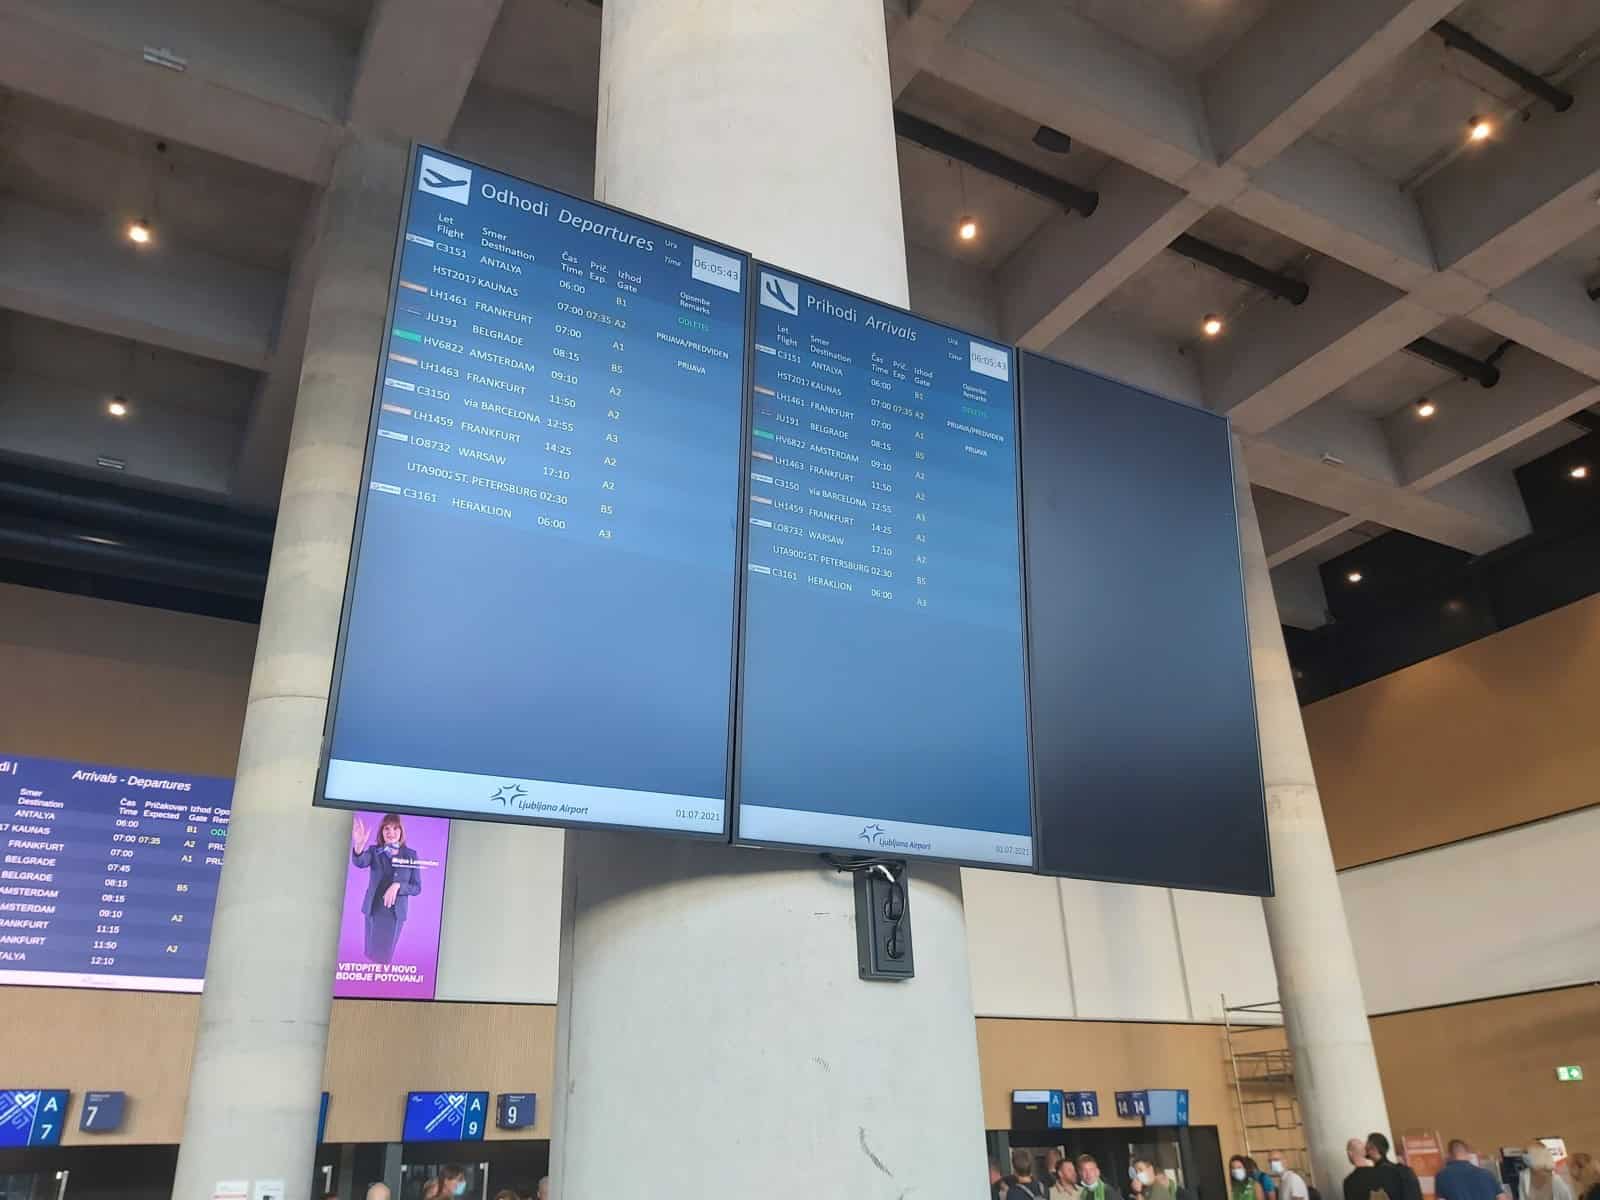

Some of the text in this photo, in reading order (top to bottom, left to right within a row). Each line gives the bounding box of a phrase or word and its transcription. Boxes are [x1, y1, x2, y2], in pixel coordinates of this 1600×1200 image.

[481, 184, 656, 252] Odhodi Departures
[437, 224, 464, 240] Flight
[481, 238, 535, 262] Destination
[562, 263, 584, 277] Time
[617, 282, 638, 294] Gate
[438, 213, 454, 224] Let
[482, 228, 508, 240] Smer
[562, 250, 578, 264] Čas
[618, 270, 642, 284] Izhod
[436, 242, 586, 294] C3151 ANTALYA 06:00
[694, 258, 738, 280] 06:05:43
[432, 265, 476, 284] HST2017
[477, 278, 520, 297] KAUNAS
[557, 302, 584, 316] 07:00
[614, 316, 627, 328] A2
[430, 290, 624, 352] LH1461 FRANKFURT 07:00 A1
[807, 295, 918, 342] Prihodi Arrivals
[425, 312, 623, 374] JU191 BELGRADE 08:15 B5
[777, 334, 798, 348] Flight
[810, 344, 852, 362] Destination
[872, 364, 889, 375] Time
[424, 335, 622, 396] HV6822 AMSTERDAM 09:10 A2
[778, 350, 892, 390] C3151 ANTALYA 06:00
[420, 360, 620, 420] LH1463 FRANKFURT 11:50 A2
[777, 370, 912, 417] HST2017 KAUNAS 07:00 07:35
[416, 385, 619, 443] C3150 via BARCELONA 12:55 A3
[776, 391, 892, 431] LH1461 FRANKFURT 07:00
[414, 410, 617, 467] LH1459 FRANKFURT 14:25 A2
[776, 413, 800, 426] JU191
[810, 422, 849, 440] BELGRADE
[410, 435, 616, 490] LO8732 WARSAW 17:10 A2
[810, 443, 860, 464] AMSTERDAM
[871, 459, 892, 472] 09:10
[776, 456, 892, 493] LH1463 FRANKFURT 11:50
[454, 472, 469, 484] ST.
[472, 475, 538, 499] PETERSBURG
[540, 491, 568, 505] 02:30
[600, 504, 613, 514] B5
[808, 487, 820, 497] via
[822, 489, 867, 508] BARCELONA
[871, 502, 892, 514] 12:55
[403, 487, 438, 504] C3161
[452, 497, 512, 519] HERAKLION
[538, 516, 566, 530] 06:00
[774, 500, 804, 515] LH1459
[808, 508, 856, 526] FRANKFURT
[808, 530, 892, 557] WARSAW 17:10
[821, 555, 870, 574] PETERSBURG
[871, 566, 892, 578] 02:30
[772, 567, 892, 600] C3161 HERAKLION 06:00
[72, 770, 192, 792] Arrivals Departures
[18, 796, 180, 820] Destination Time Expected
[518, 800, 588, 816] Ljubljana Airport
[676, 808, 720, 822] 01.07.2021
[14, 809, 56, 821] ANTALYA
[186, 825, 198, 834] B1
[12, 824, 52, 836] KAUNAS
[113, 834, 136, 843] 07:00
[184, 840, 196, 848] A2
[4, 855, 57, 867] BELGRADE
[8, 839, 193, 863] FRANKFURT 07:00 A1
[1, 870, 53, 882] BELGRADE
[0, 886, 59, 898] AMSTERDAM
[96, 925, 120, 934] 11:15
[93, 940, 118, 950] 11:50
[90, 956, 114, 966] 12:10
[338, 963, 417, 974] VSTOPITE V NOVO
[43, 1096, 58, 1112] A
[470, 1100, 481, 1112] A
[1052, 1096, 1059, 1104] A
[1066, 1102, 1076, 1116] 13
[1082, 1100, 1093, 1114] 13
[1118, 1101, 1128, 1114] 14
[1134, 1100, 1144, 1114] 14
[1178, 1096, 1185, 1104] A
[86, 1106, 98, 1126] 7
[508, 1106, 517, 1124] 9
[1052, 1113, 1061, 1123] 13
[40, 1124, 53, 1140] 7
[468, 1122, 478, 1135] 9
